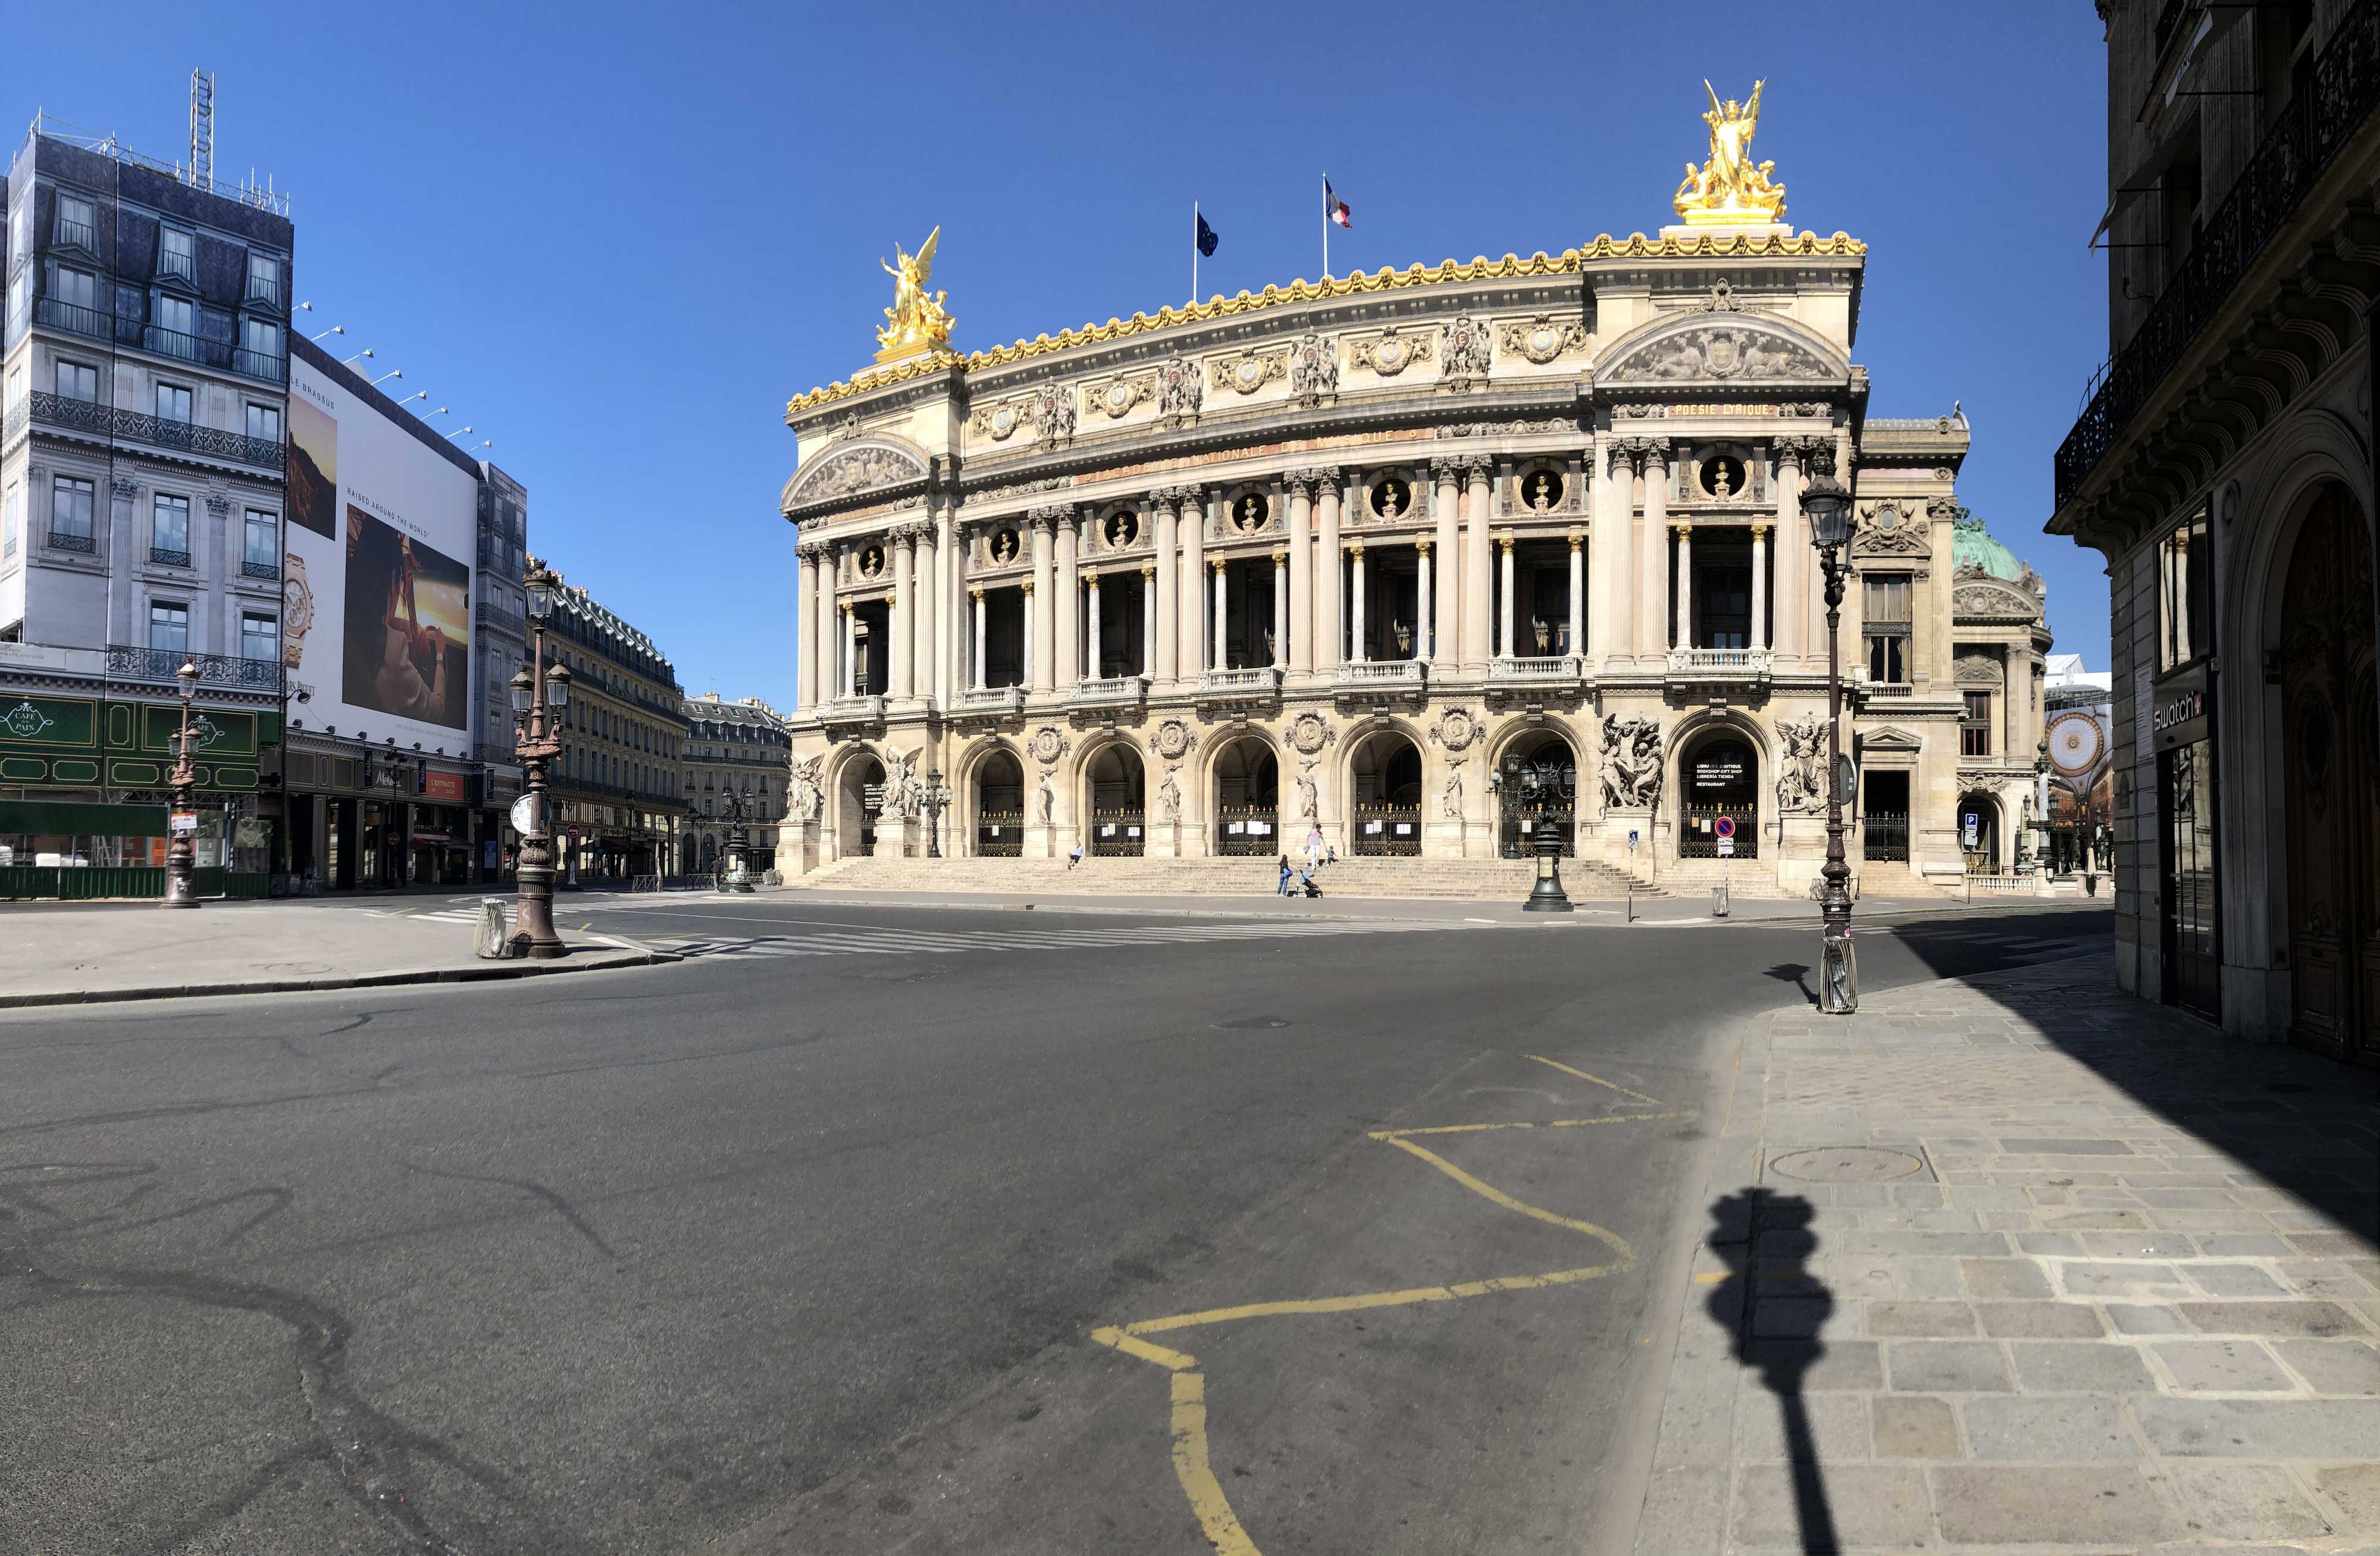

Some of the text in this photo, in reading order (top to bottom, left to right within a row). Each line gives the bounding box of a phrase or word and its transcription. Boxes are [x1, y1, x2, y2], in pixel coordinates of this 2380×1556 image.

[1458, 333, 1466, 344] E
[1307, 350, 1314, 360] E
[1171, 374, 1178, 383] E
[291, 375, 334, 409] LE BRASSUS
[1047, 399, 1053, 409] E
[1676, 404, 1768, 416] POESIE LYRIQUE
[1102, 430, 1394, 480] ACADEMIE NATIONALE DE MUSIQUE
[347, 487, 369, 505] RAISED
[372, 502, 394, 519] AROUND
[397, 515, 407, 527] THE
[2154, 693, 2194, 731] swatch
[431, 779, 455, 788] L'ENTRACTE
